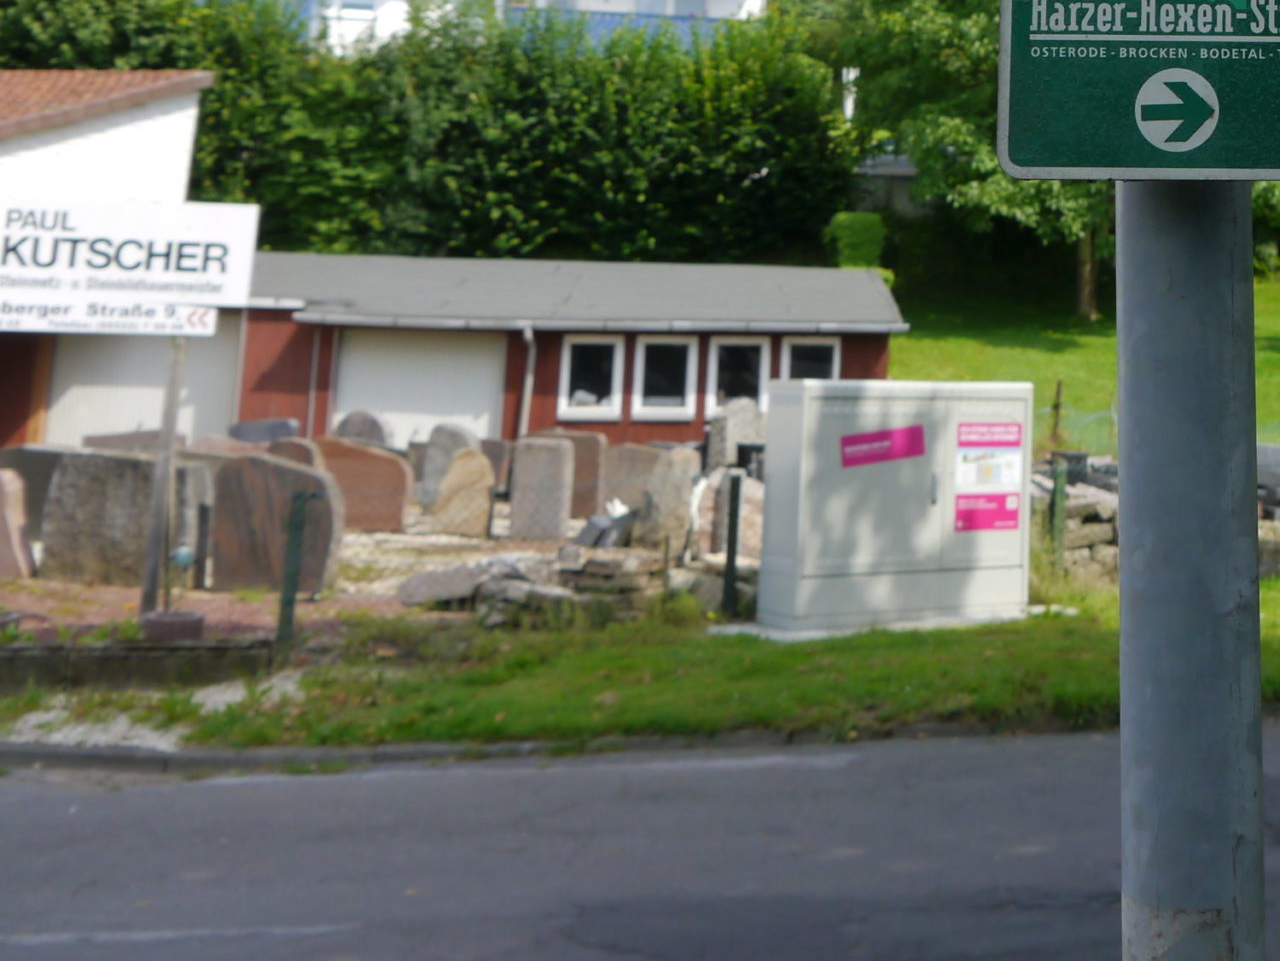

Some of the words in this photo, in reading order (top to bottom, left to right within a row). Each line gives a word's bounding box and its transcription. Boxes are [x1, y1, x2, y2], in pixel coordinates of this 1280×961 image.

[1030, 46, 1107, 58] OSTERODE
[1119, 47, 1188, 59] BROCKEN
[1200, 48, 1266, 60] BODETAL
[5, 209, 76, 232] PAUL
[1, 236, 229, 273] KUTSCHER
